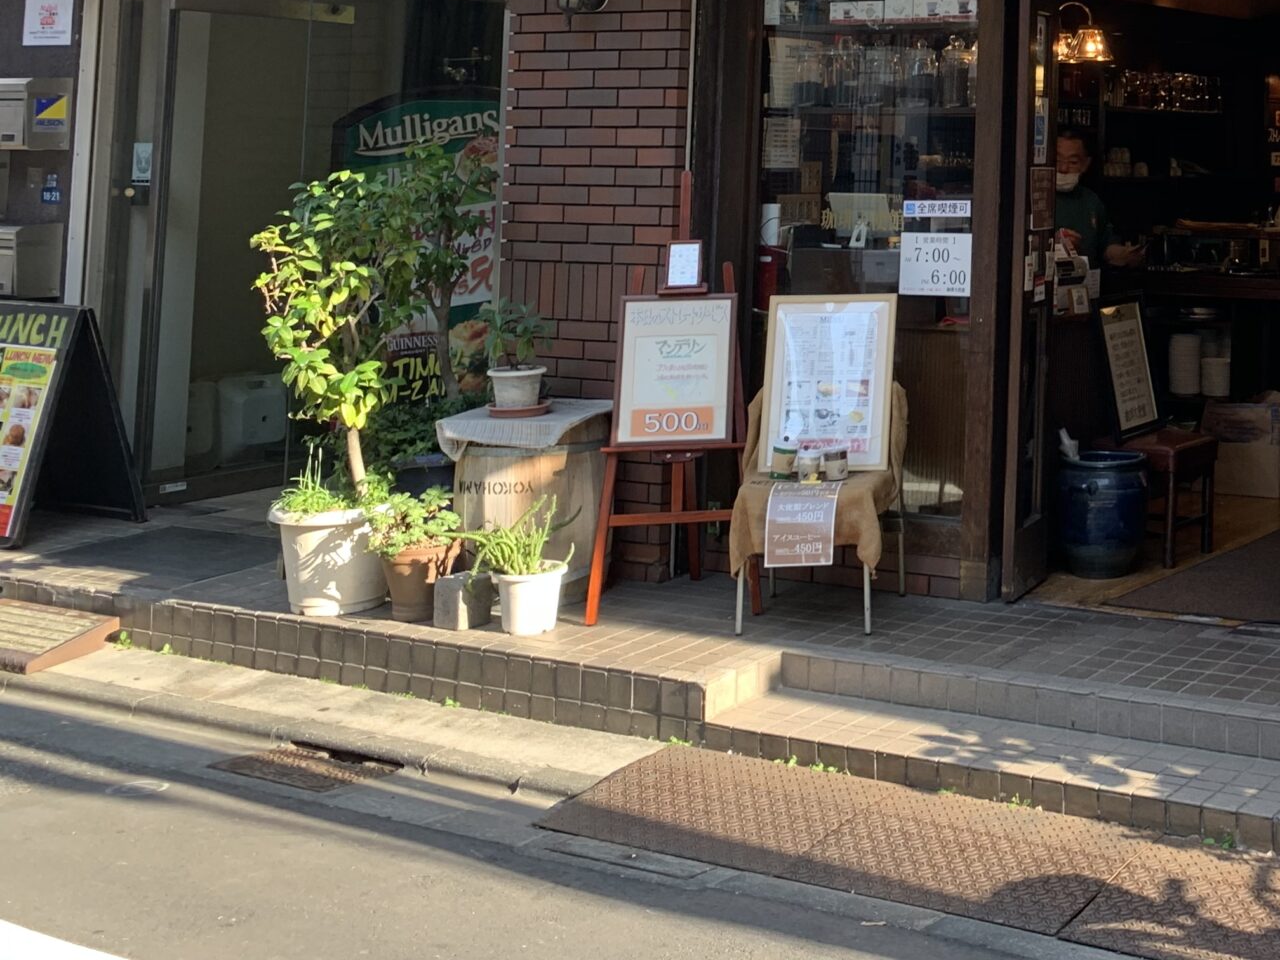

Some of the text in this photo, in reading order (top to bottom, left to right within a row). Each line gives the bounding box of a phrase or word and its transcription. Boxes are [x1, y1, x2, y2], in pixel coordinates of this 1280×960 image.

[355, 110, 499, 156] Mulligans
[917, 202, 968, 215] 全席喫煙可
[914, 247, 950, 262] 7:00
[931, 270, 966, 285] 6:00
[0, 312, 68, 349] UNCH
[386, 335, 438, 352] GUINNESS
[655, 339, 708, 356] マンデリン
[643, 410, 698, 434] 500
